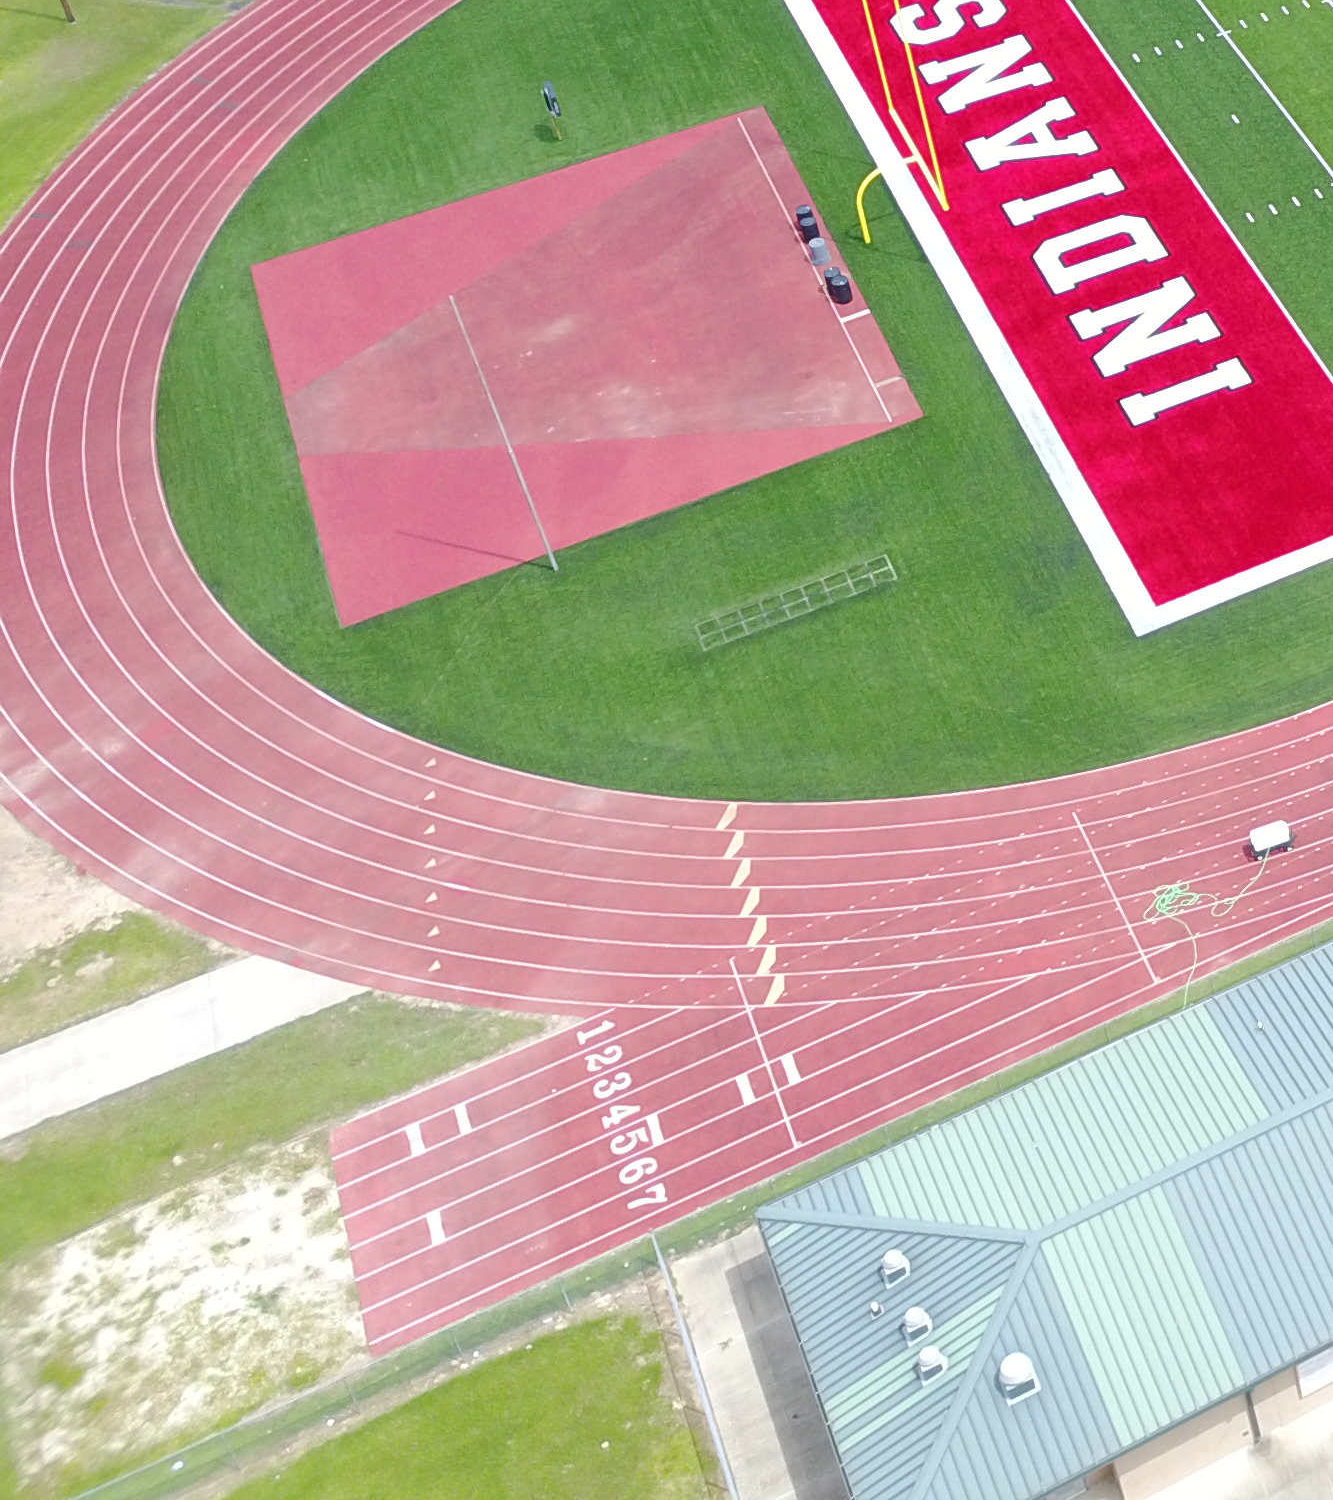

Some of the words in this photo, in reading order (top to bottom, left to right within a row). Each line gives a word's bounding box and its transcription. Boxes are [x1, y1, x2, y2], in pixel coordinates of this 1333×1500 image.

[576, 1019, 615, 1046] 1
[585, 1045, 623, 1072] 2
[593, 1071, 633, 1099] 3
[600, 1103, 640, 1129] 4
[609, 1126, 650, 1156] 5
[617, 1156, 658, 1185] 6
[627, 1183, 668, 1210] 7
